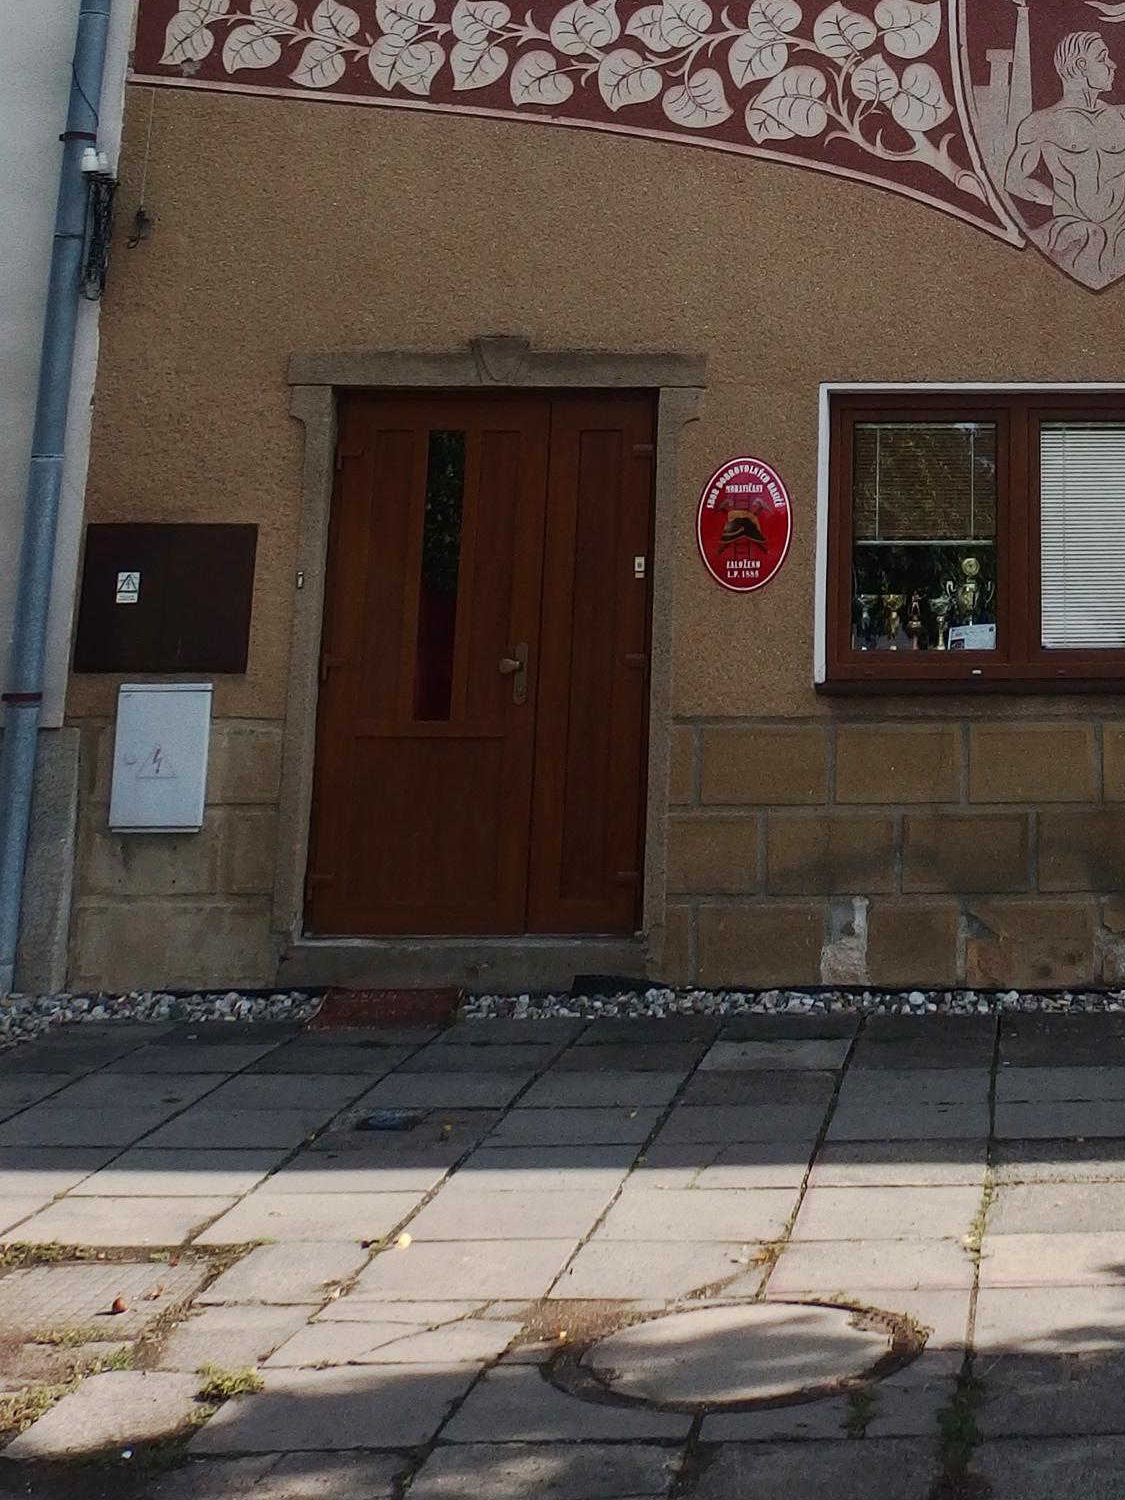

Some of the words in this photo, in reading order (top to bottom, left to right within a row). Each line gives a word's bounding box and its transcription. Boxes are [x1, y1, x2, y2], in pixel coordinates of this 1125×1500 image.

[707, 488, 719, 508] SBOR
[716, 465, 770, 488] DOBROVOLNÝCH
[726, 559, 760, 569] ZALOŽENO
